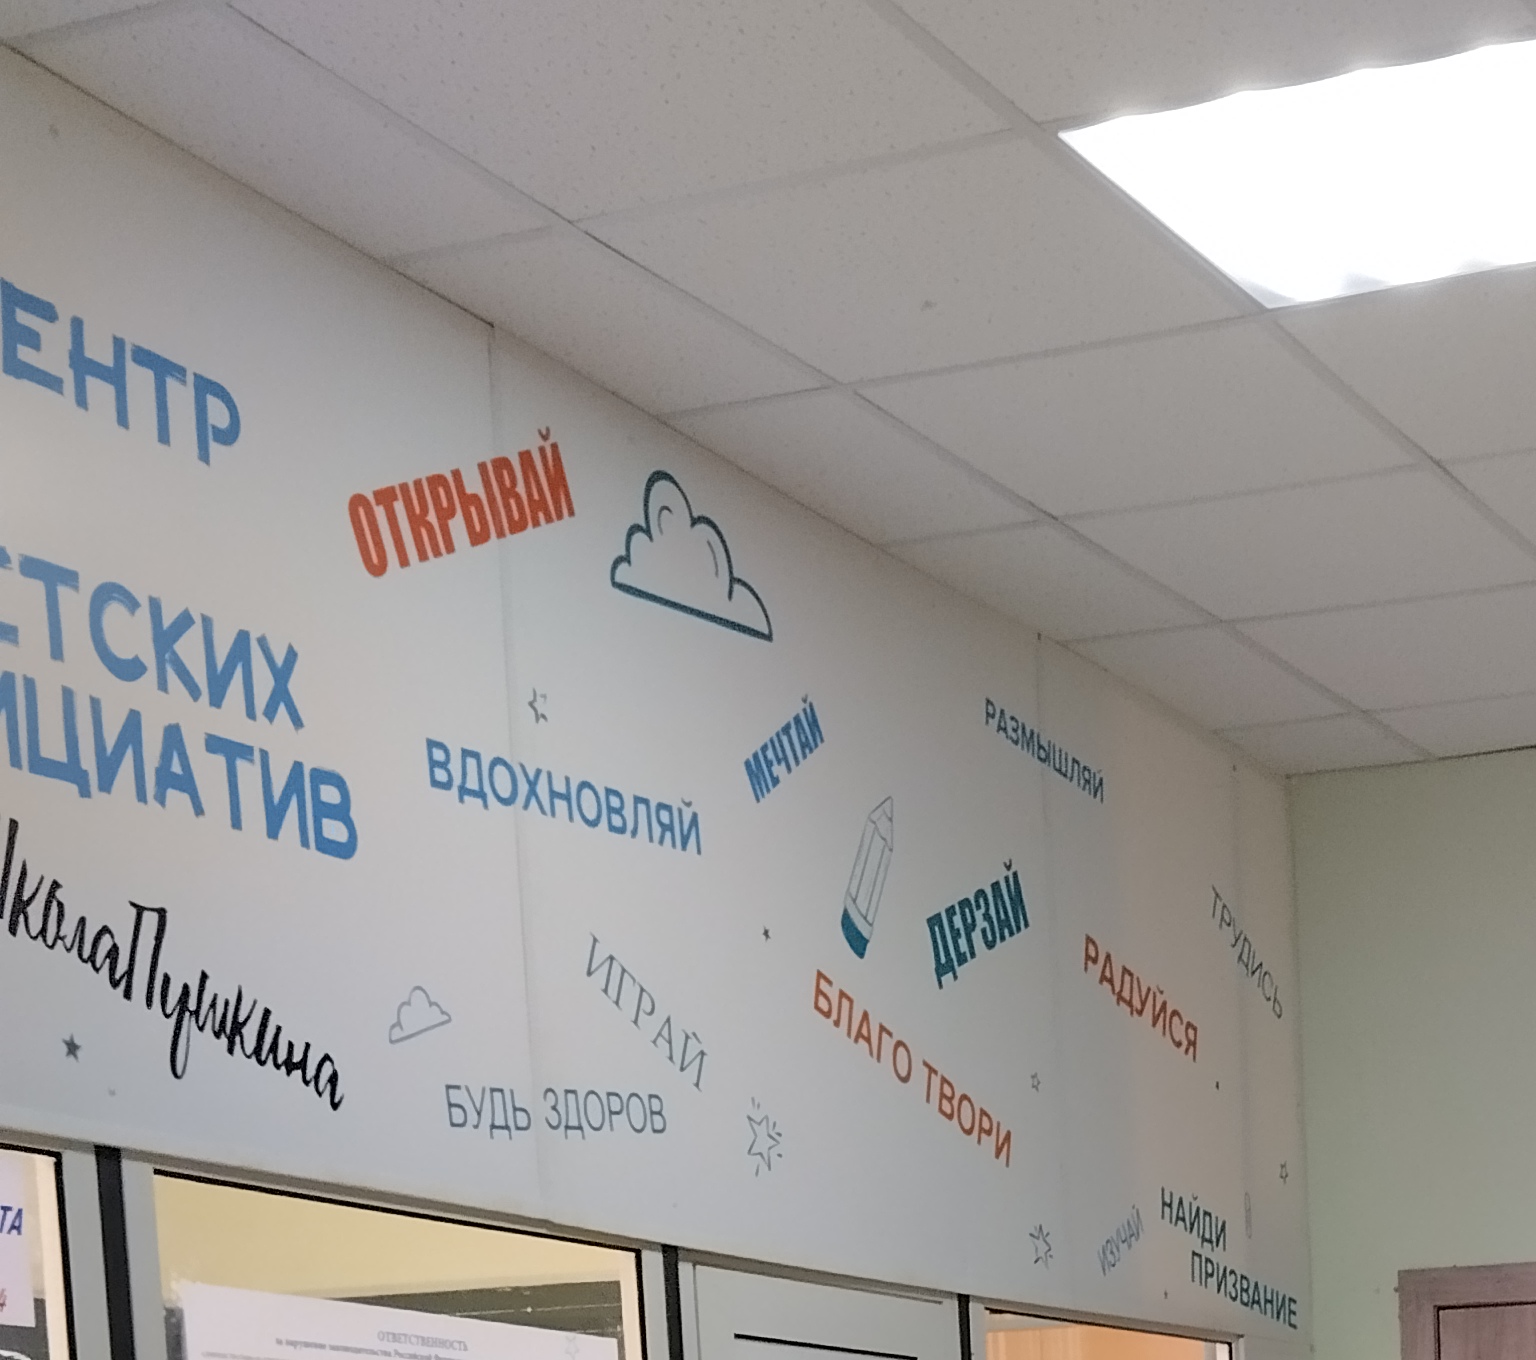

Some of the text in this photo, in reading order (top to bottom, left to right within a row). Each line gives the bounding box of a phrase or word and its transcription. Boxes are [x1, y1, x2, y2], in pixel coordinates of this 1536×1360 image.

[0, 278, 241, 466] ЕНТР
[348, 427, 575, 577] ОТКРЫВАЙ
[426, 738, 702, 855] ВДОХНОВЛЯЙ
[744, 694, 825, 803] МЕЧТАЙ
[984, 698, 1104, 803] РАЗМЫШЛЯЙ
[926, 858, 1030, 989] ДЕРЗАЙ
[1212, 884, 1283, 1019] ТРУДИСЬ
[586, 932, 707, 1091] ИГРАЙ
[1085, 934, 1198, 1061] РАДУЙСЯ
[445, 1084, 667, 1140] БУДЬ ЗДОРОВ
[814, 970, 1013, 1168] БЛАГО ТВОРИ
[1098, 1204, 1144, 1276] ИЗУЧАЙ
[1161, 1186, 1226, 1251] НАЙДИ
[1191, 1250, 1298, 1330] ПРИЗВАНИЕ
